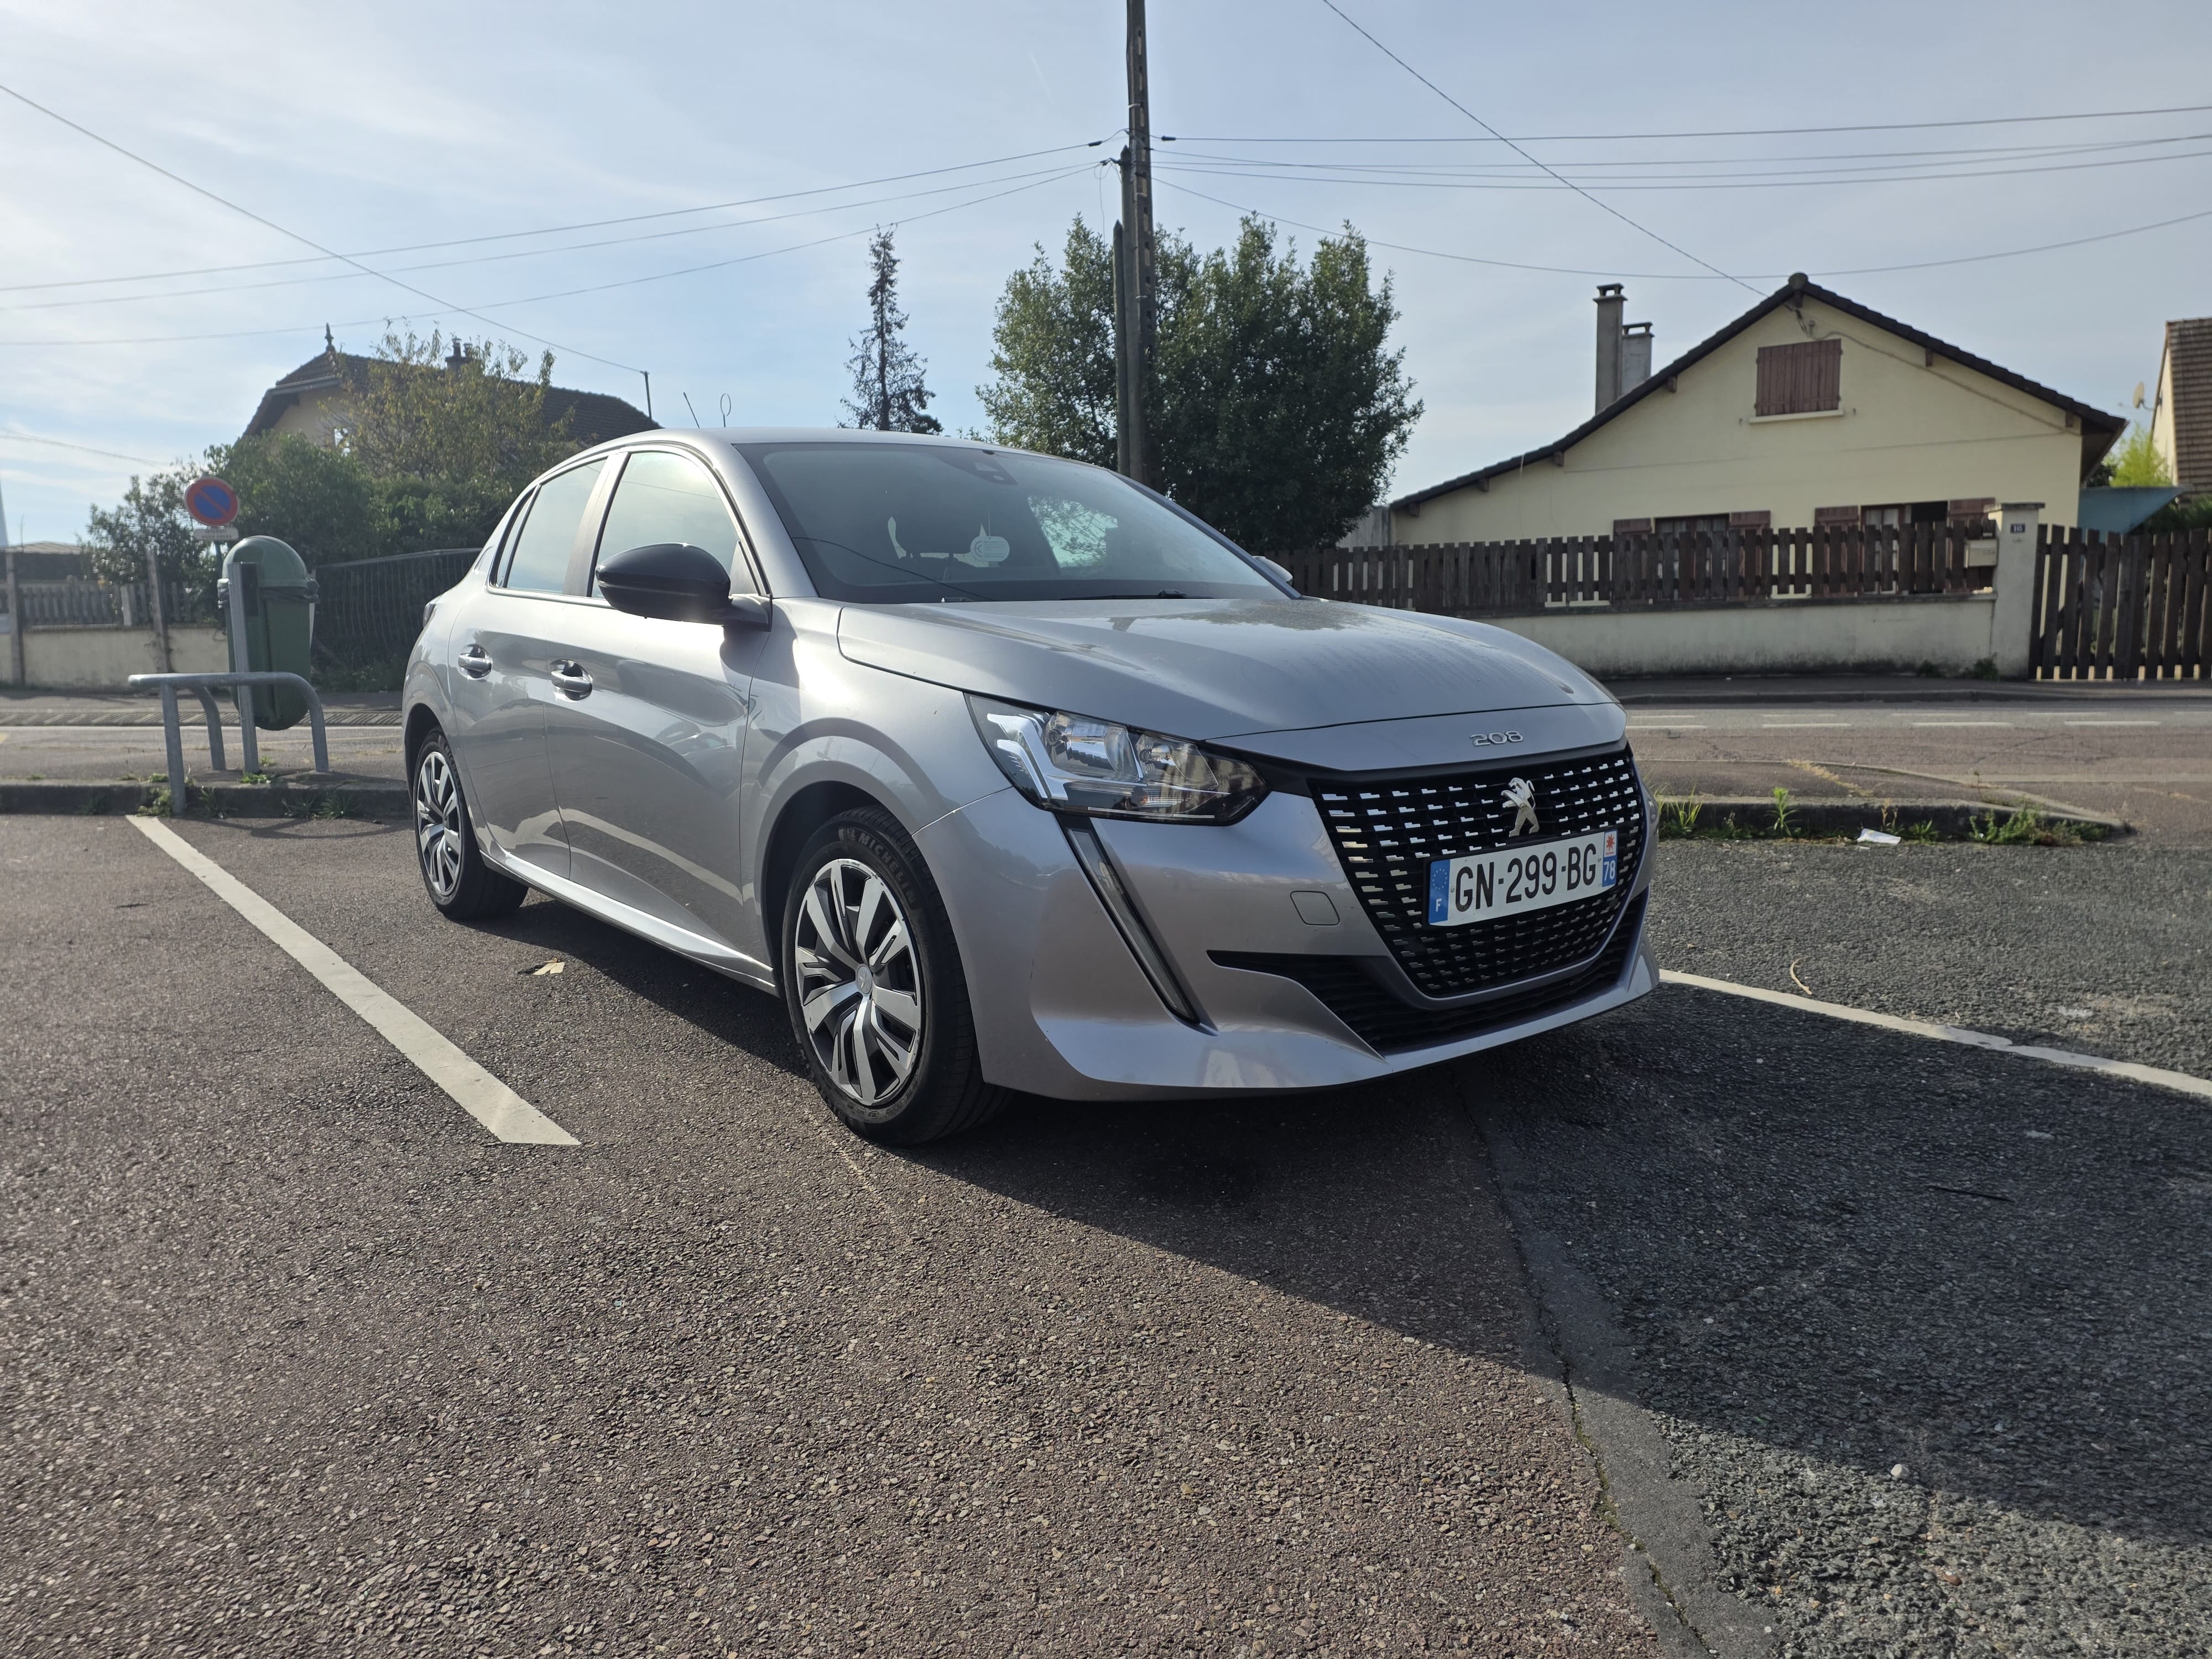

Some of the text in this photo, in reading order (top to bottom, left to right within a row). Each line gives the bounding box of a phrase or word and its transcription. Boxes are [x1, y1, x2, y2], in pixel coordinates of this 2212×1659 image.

[1470, 731, 1524, 747] 208
[858, 832, 917, 904] MICHELIN
[1435, 843, 1616, 912] F GN-299-BG 78
